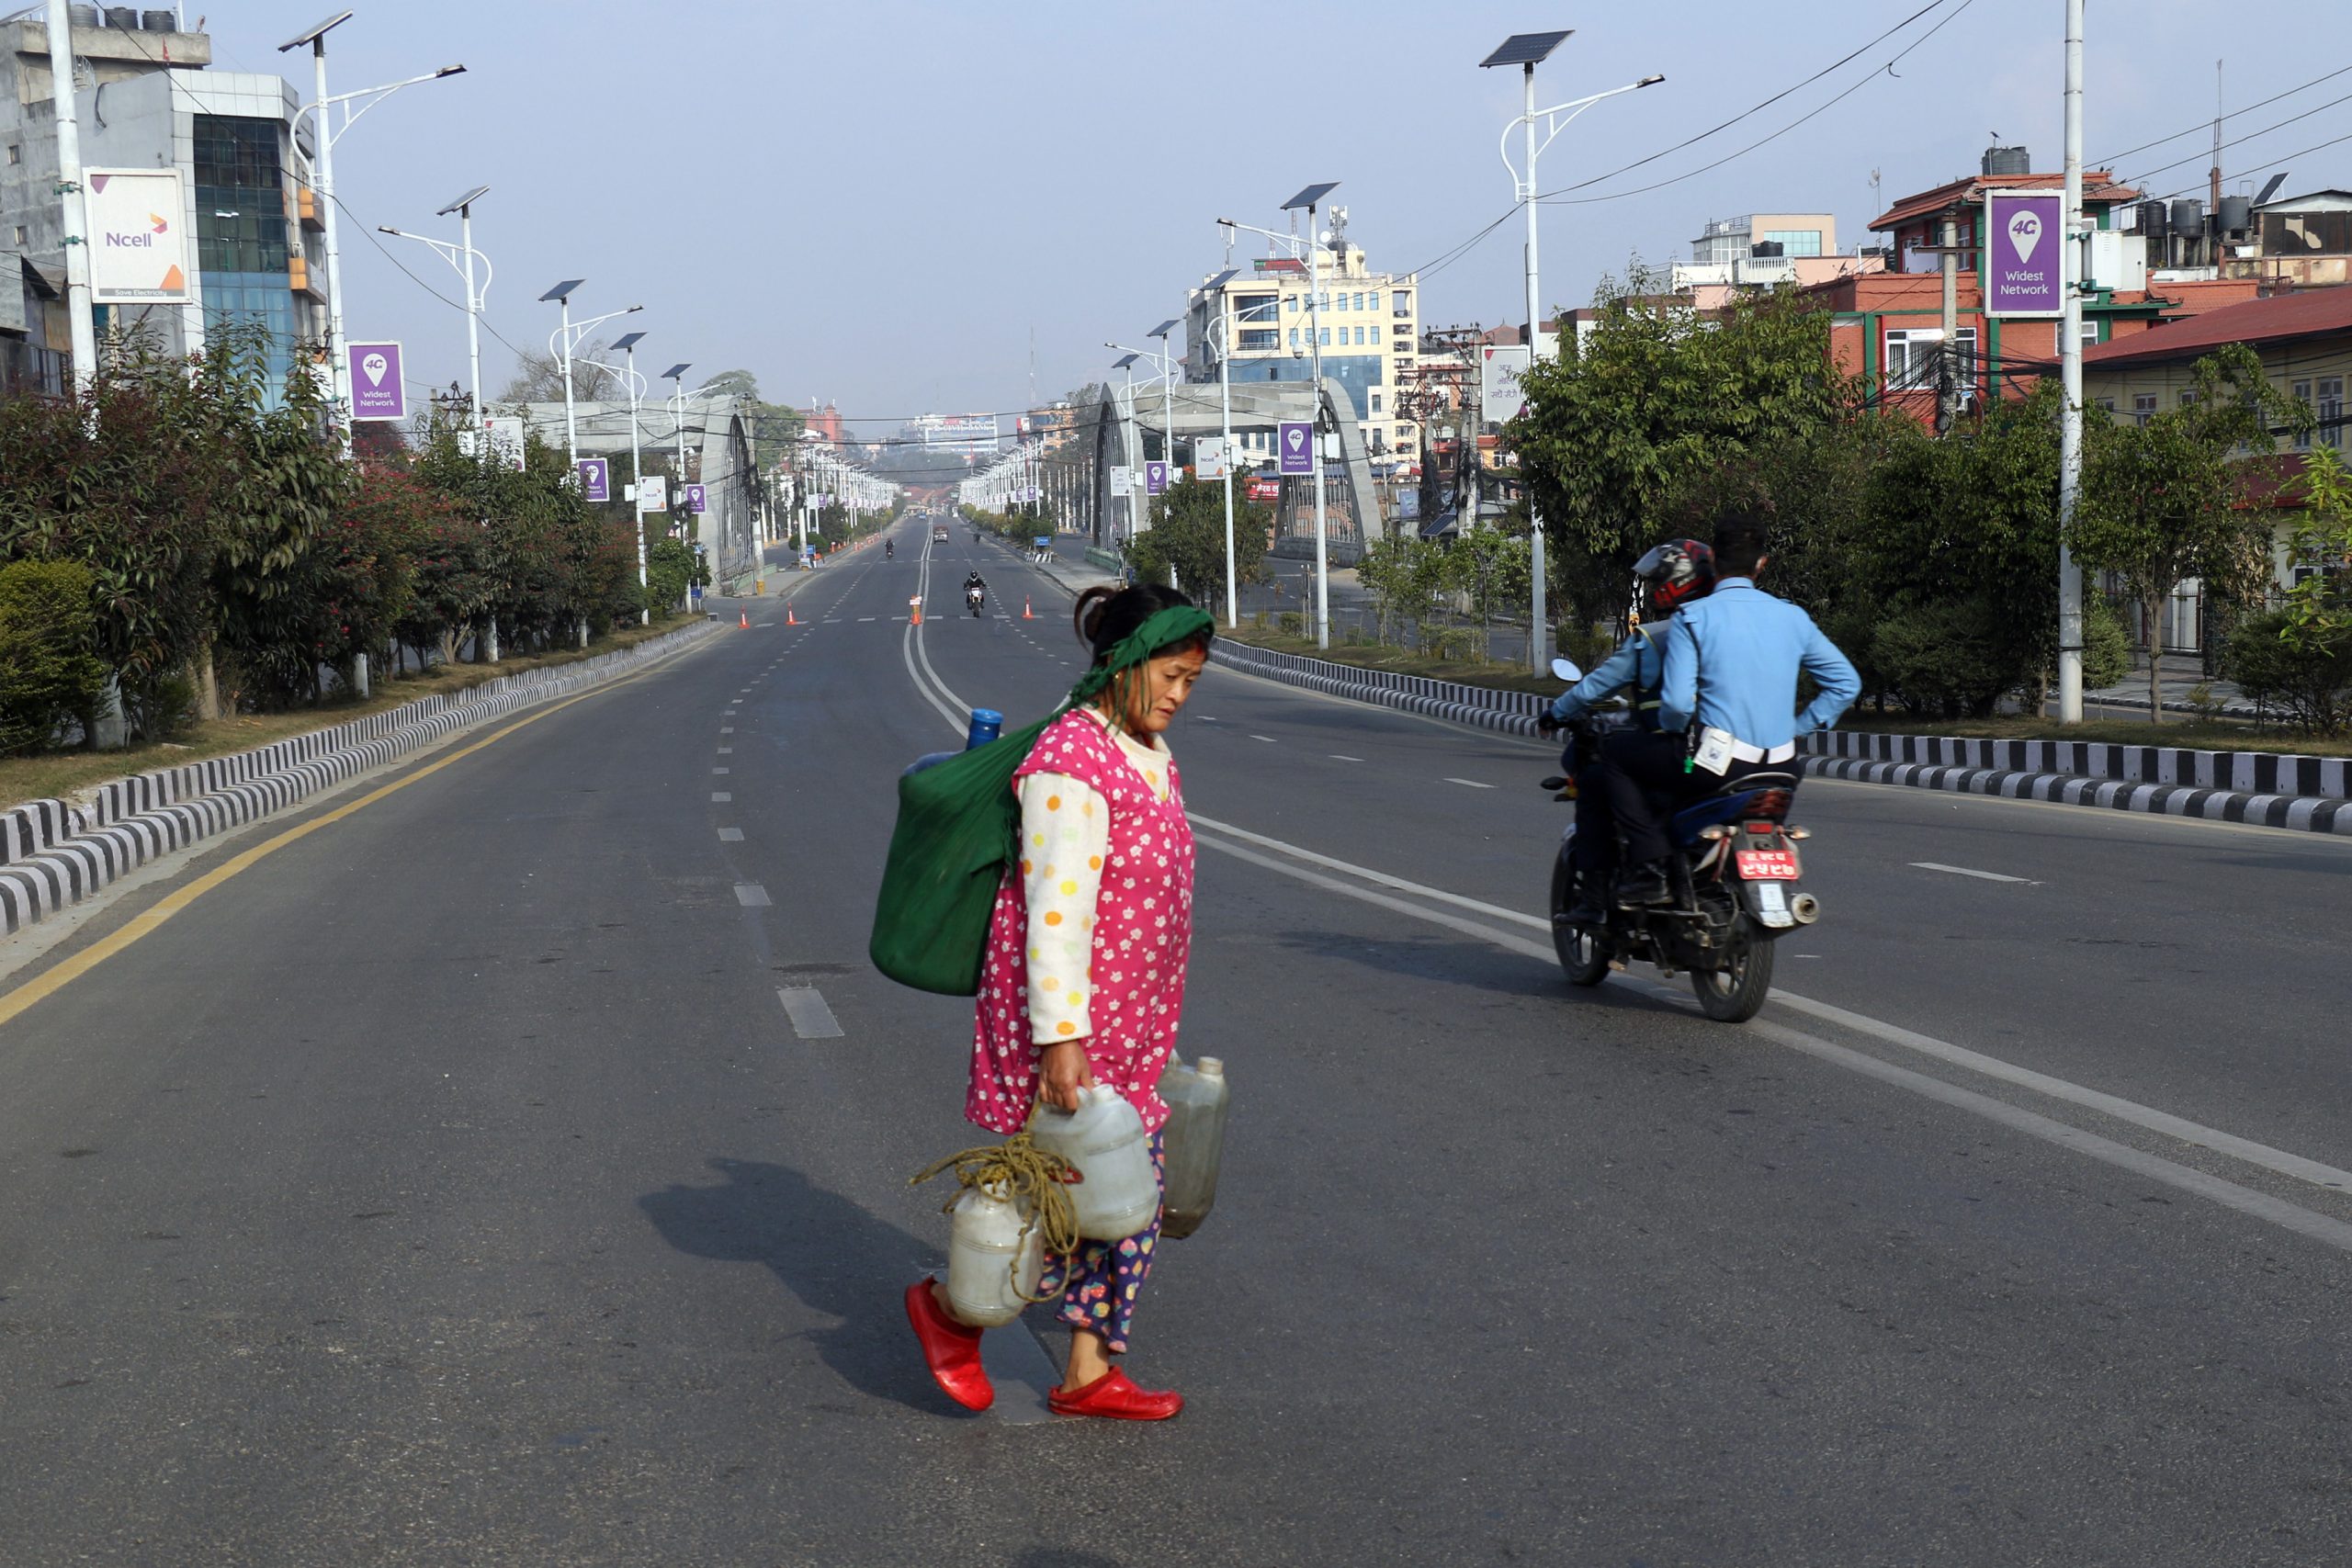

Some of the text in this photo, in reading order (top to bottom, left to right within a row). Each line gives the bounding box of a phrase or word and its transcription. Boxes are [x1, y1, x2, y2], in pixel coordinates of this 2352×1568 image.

[106, 231, 152, 248] Ncell
[2005, 270, 2044, 282] Widest
[2000, 284, 2049, 295] Network
[362, 390, 391, 399] Widest
[360, 399, 395, 407] Network
